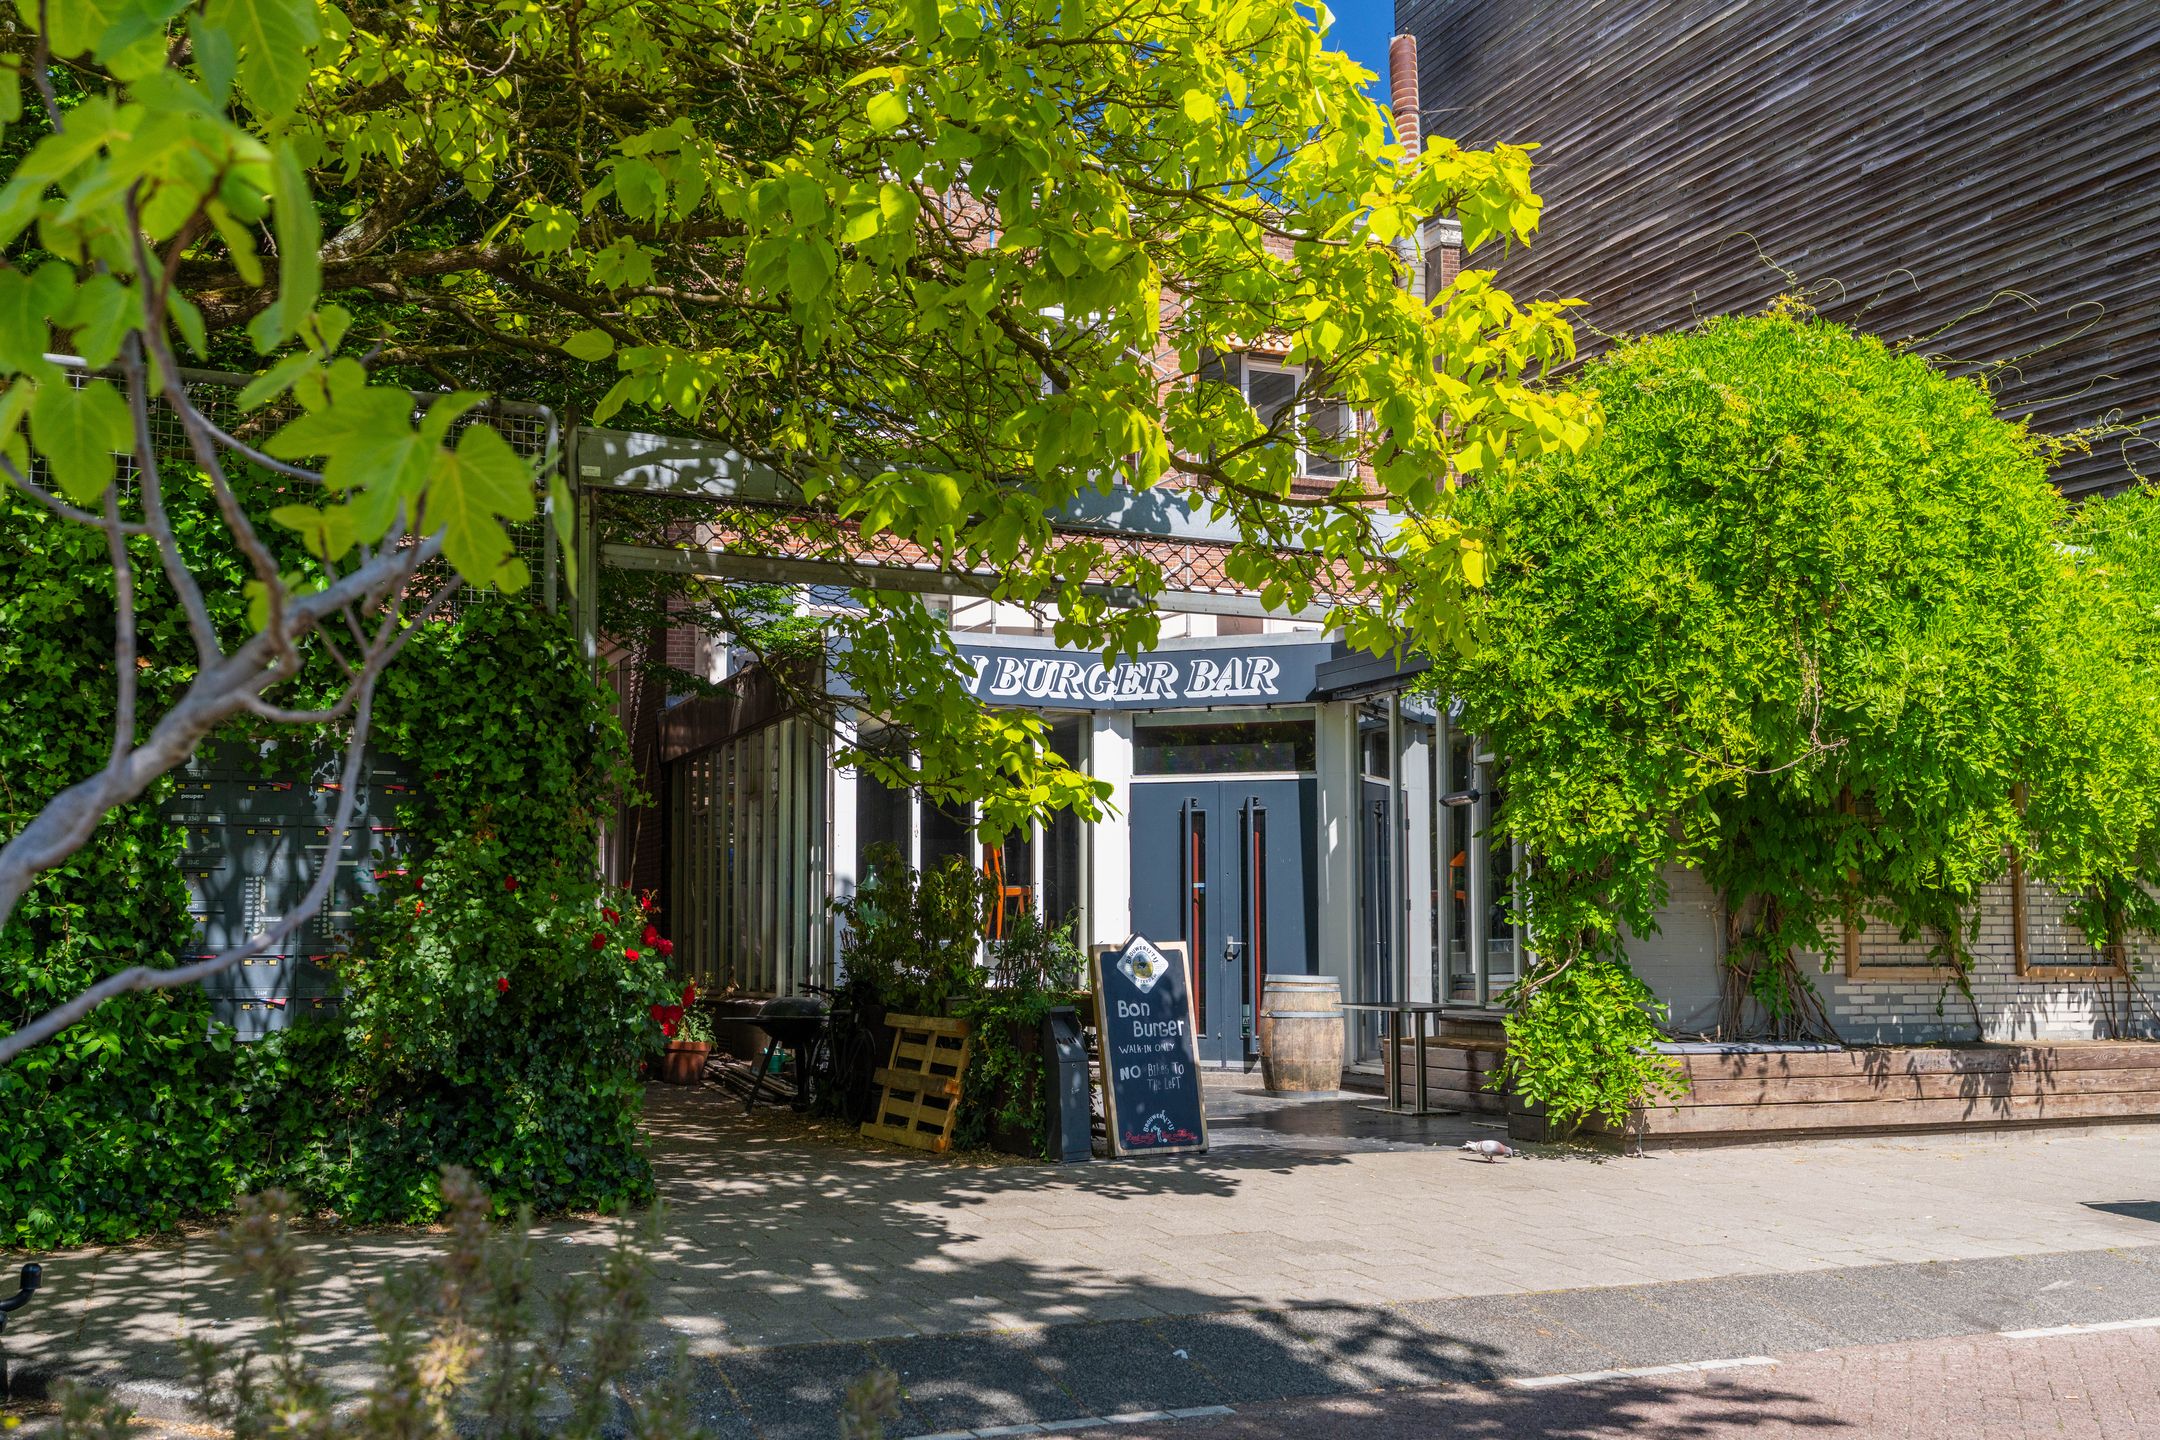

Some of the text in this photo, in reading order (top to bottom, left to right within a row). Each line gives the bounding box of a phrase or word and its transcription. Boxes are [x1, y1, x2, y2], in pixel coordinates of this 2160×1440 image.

[989, 655, 1180, 702] BURGER
[1184, 655, 1280, 698] BAR
[1117, 1000, 1150, 1018] Bon
[1154, 1042, 1176, 1052] ONLY
[1119, 1065, 1142, 1081] NO
[1171, 1061, 1185, 1075] TO
